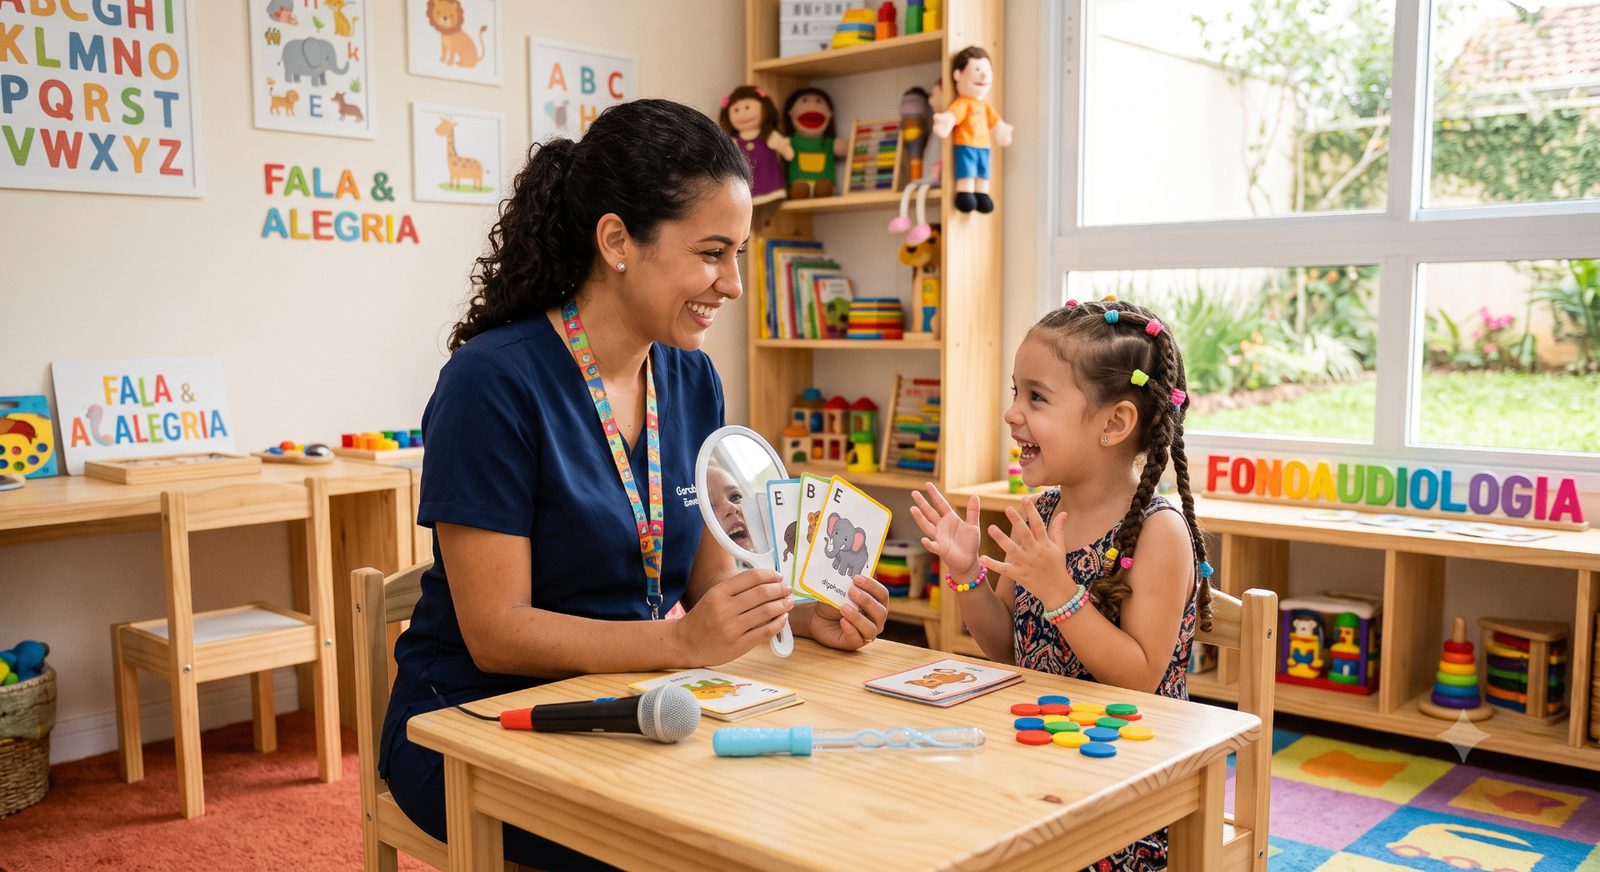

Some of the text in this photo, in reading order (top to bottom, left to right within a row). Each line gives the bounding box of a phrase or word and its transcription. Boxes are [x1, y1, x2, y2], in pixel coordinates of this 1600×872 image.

[309, 95, 323, 118] E
[264, 163, 395, 202] FALA &
[261, 207, 420, 244] ALEGRIA
[102, 374, 197, 408] FALA &
[114, 409, 229, 445] ALEGRIA
[774, 490, 784, 506] E
[806, 483, 816, 499] B
[833, 487, 844, 504] E
[1206, 454, 1585, 525] FONOAUDIOLOGIA
